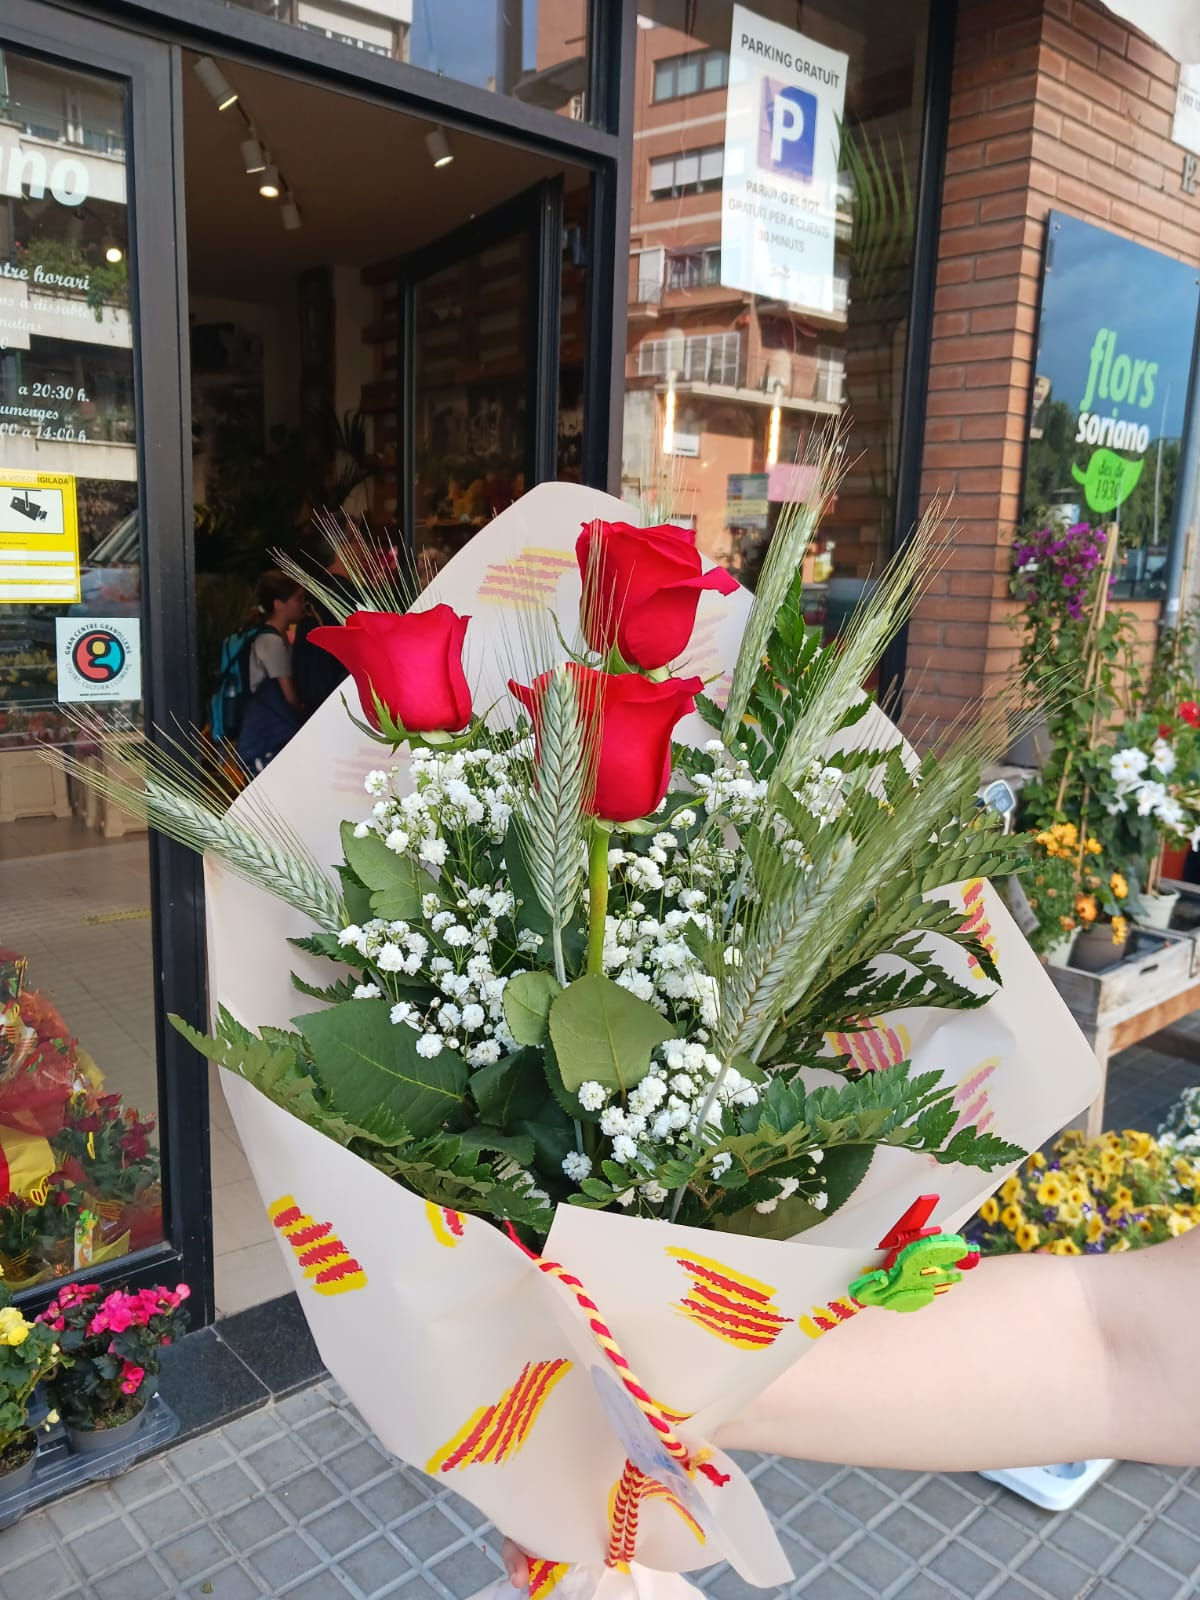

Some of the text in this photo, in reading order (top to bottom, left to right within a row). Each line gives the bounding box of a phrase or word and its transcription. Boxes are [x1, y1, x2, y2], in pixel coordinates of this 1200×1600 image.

[741, 34, 792, 69] PARKING
[0, 146, 89, 206] no
[771, 232, 805, 253] MINUTS
[34, 264, 90, 290] horari
[1079, 327, 1158, 411] flors
[18, 384, 28, 396] a
[33, 382, 73, 400] 20:30
[22, 428, 31, 439] a
[36, 426, 74, 442] 14:00
[1075, 407, 1149, 453] soriano
